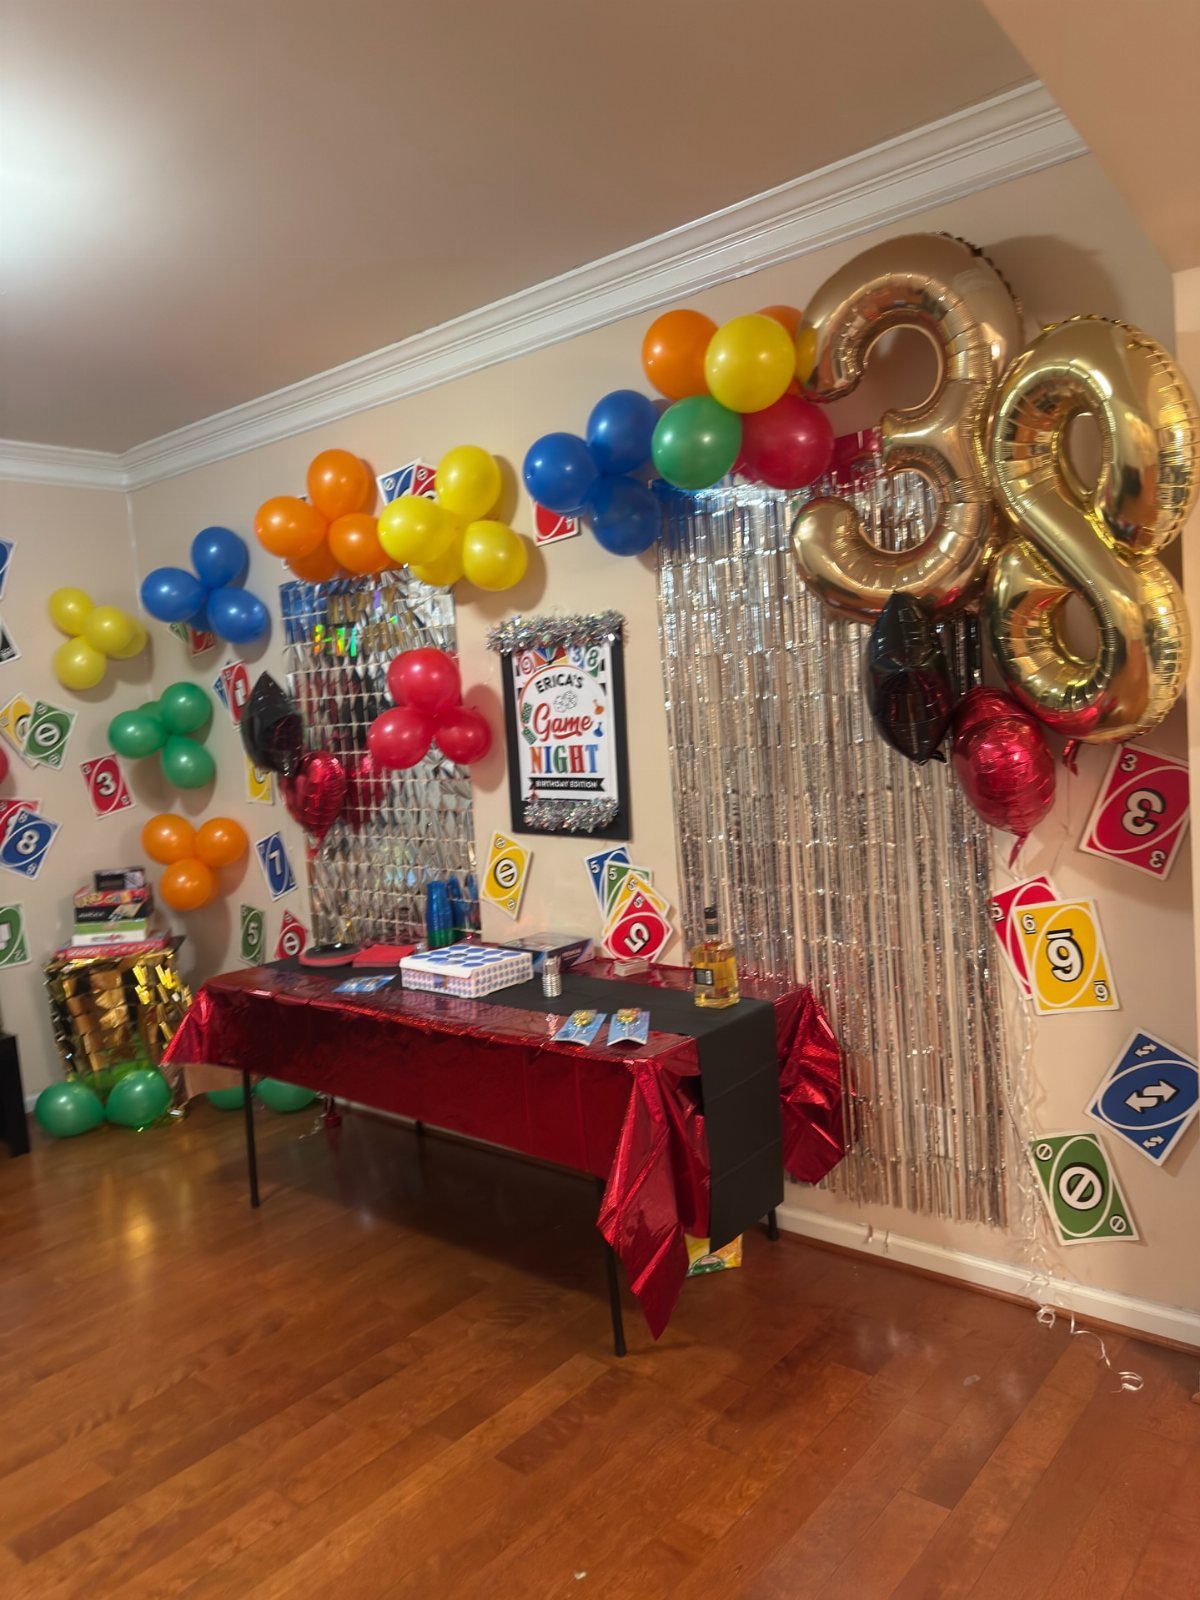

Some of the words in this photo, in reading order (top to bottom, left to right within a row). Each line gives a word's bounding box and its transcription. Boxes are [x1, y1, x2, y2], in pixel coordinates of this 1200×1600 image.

[536, 674, 583, 693] ERICA'S
[533, 703, 593, 742] Game
[530, 745, 599, 773] NIGHT
[1121, 753, 1137, 771] 3
[96, 771, 116, 796] 3
[535, 781, 568, 789] BIRTHDAY
[569, 780, 598, 789] EDITION
[1122, 788, 1166, 836] 3
[16, 830, 39, 855] 8
[269, 850, 283, 876] 7
[591, 861, 600, 873] 5
[1149, 850, 1166, 868] 3
[608, 867, 618, 880] 5
[247, 922, 259, 945] 5
[1021, 913, 1037, 935] 6
[624, 923, 649, 953] 5
[1046, 928, 1084, 982] 6
[1093, 980, 1110, 1002] 6
